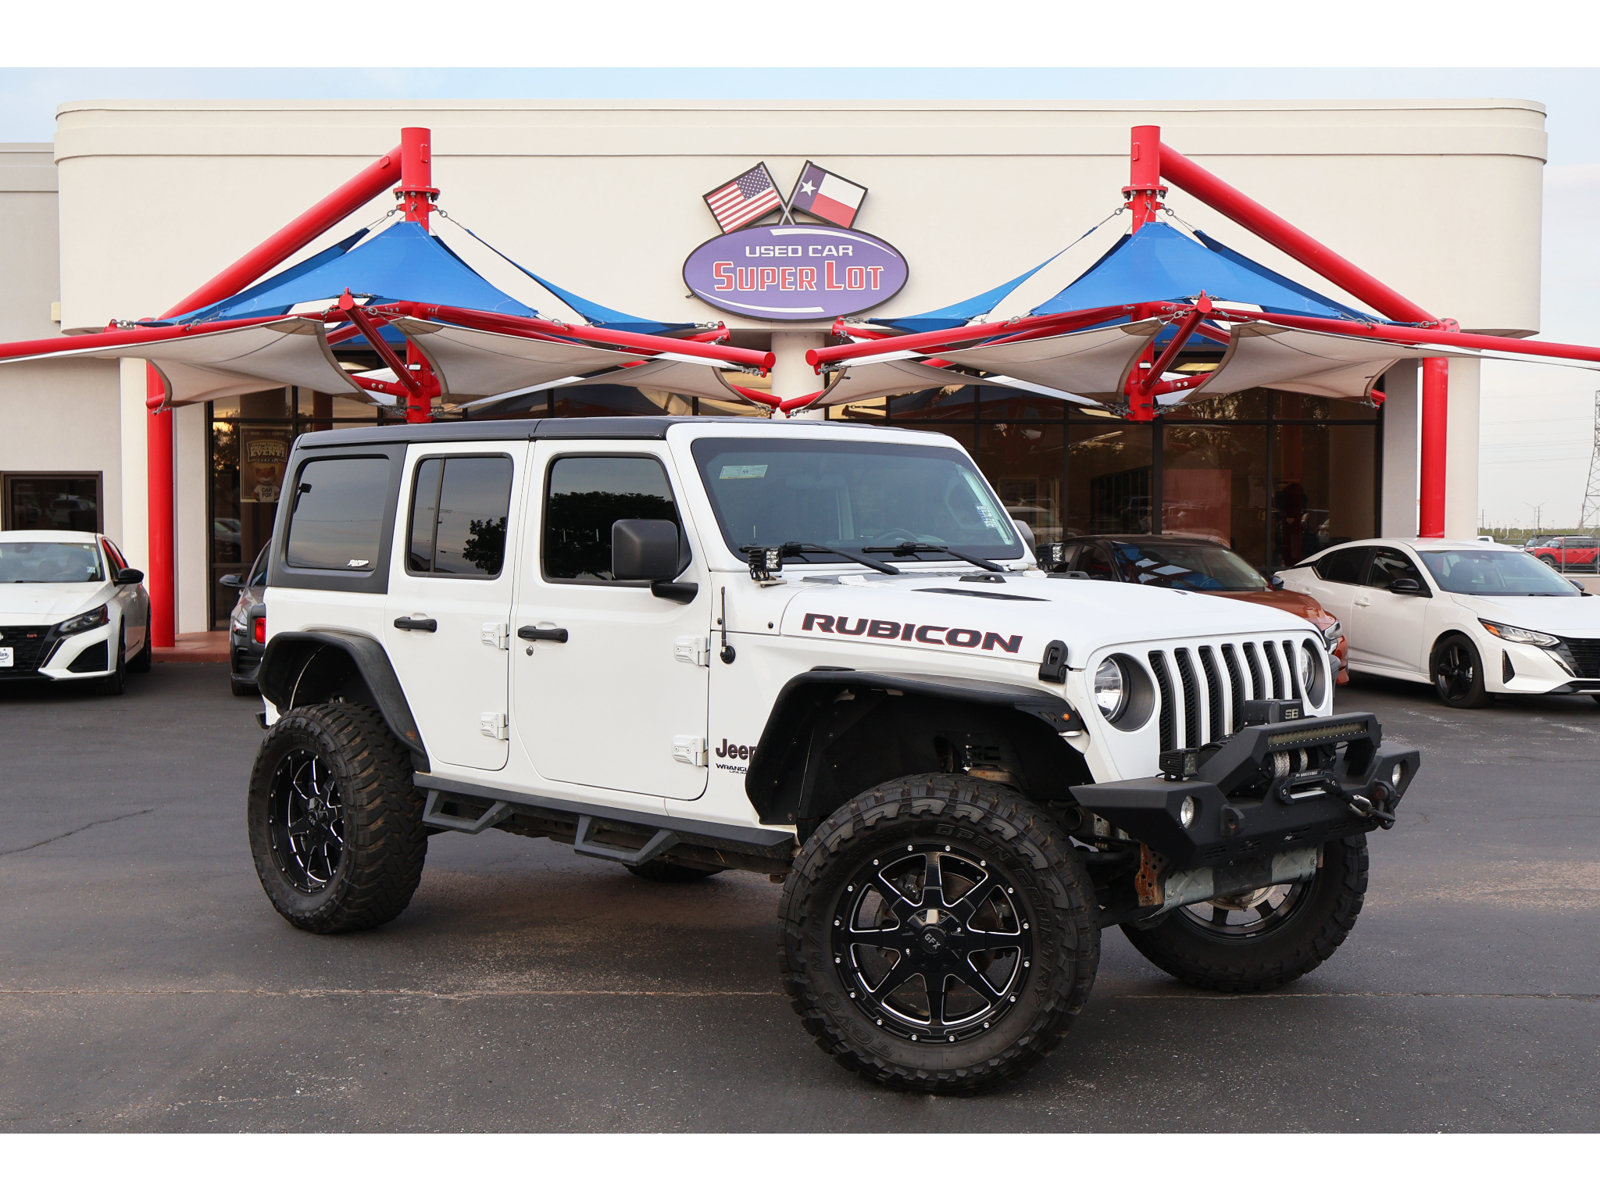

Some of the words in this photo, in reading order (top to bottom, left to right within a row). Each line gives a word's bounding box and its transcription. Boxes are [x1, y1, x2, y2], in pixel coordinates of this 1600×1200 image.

[745, 245, 802, 257] USED
[808, 245, 853, 257] CAR
[713, 261, 817, 292] SUPER
[824, 260, 884, 291] LOT
[801, 612, 1023, 654] RUBICON
[924, 933, 941, 949] GFX
[821, 991, 893, 1058] TOYO
